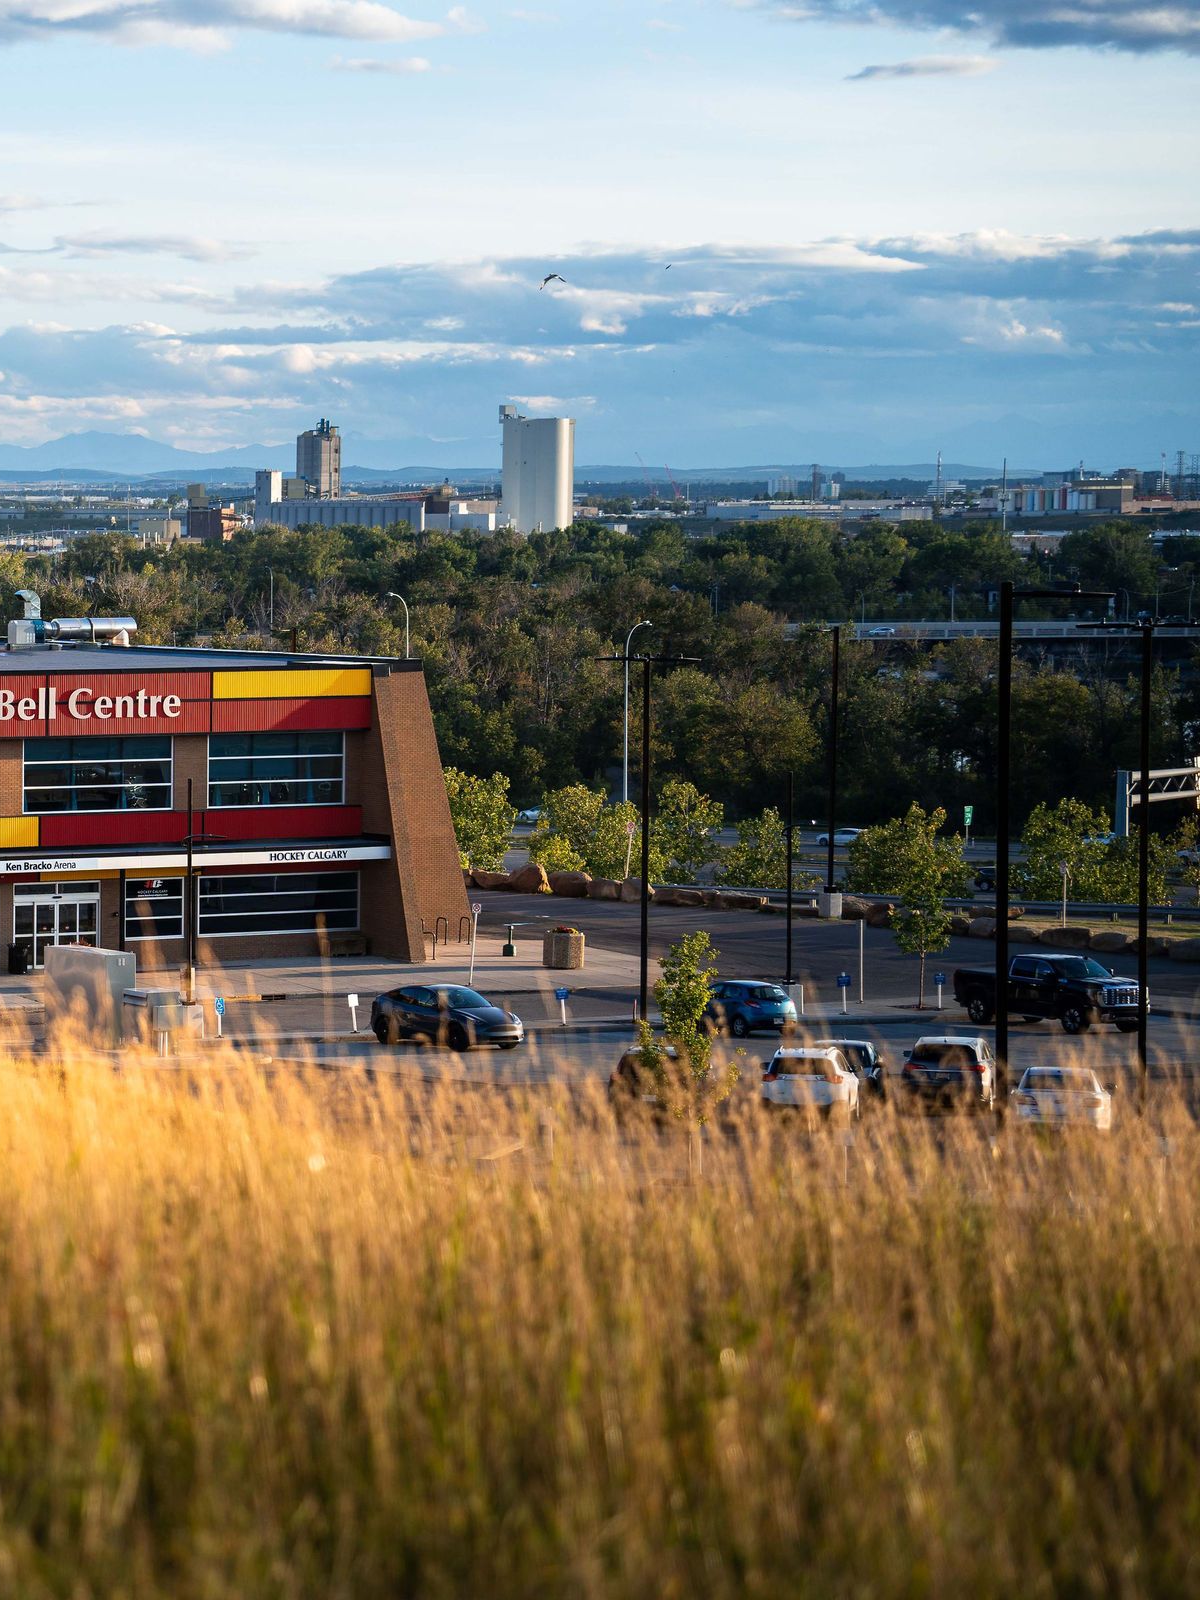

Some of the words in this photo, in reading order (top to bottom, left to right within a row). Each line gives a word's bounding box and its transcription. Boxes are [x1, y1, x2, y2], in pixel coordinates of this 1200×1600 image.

[68, 688, 181, 719] Centre
[270, 852, 306, 861] HOCKEY
[307, 850, 348, 860] CALGARY
[6, 862, 22, 871] Ken
[23, 861, 52, 871] Bracko
[53, 861, 76, 869] Arena
